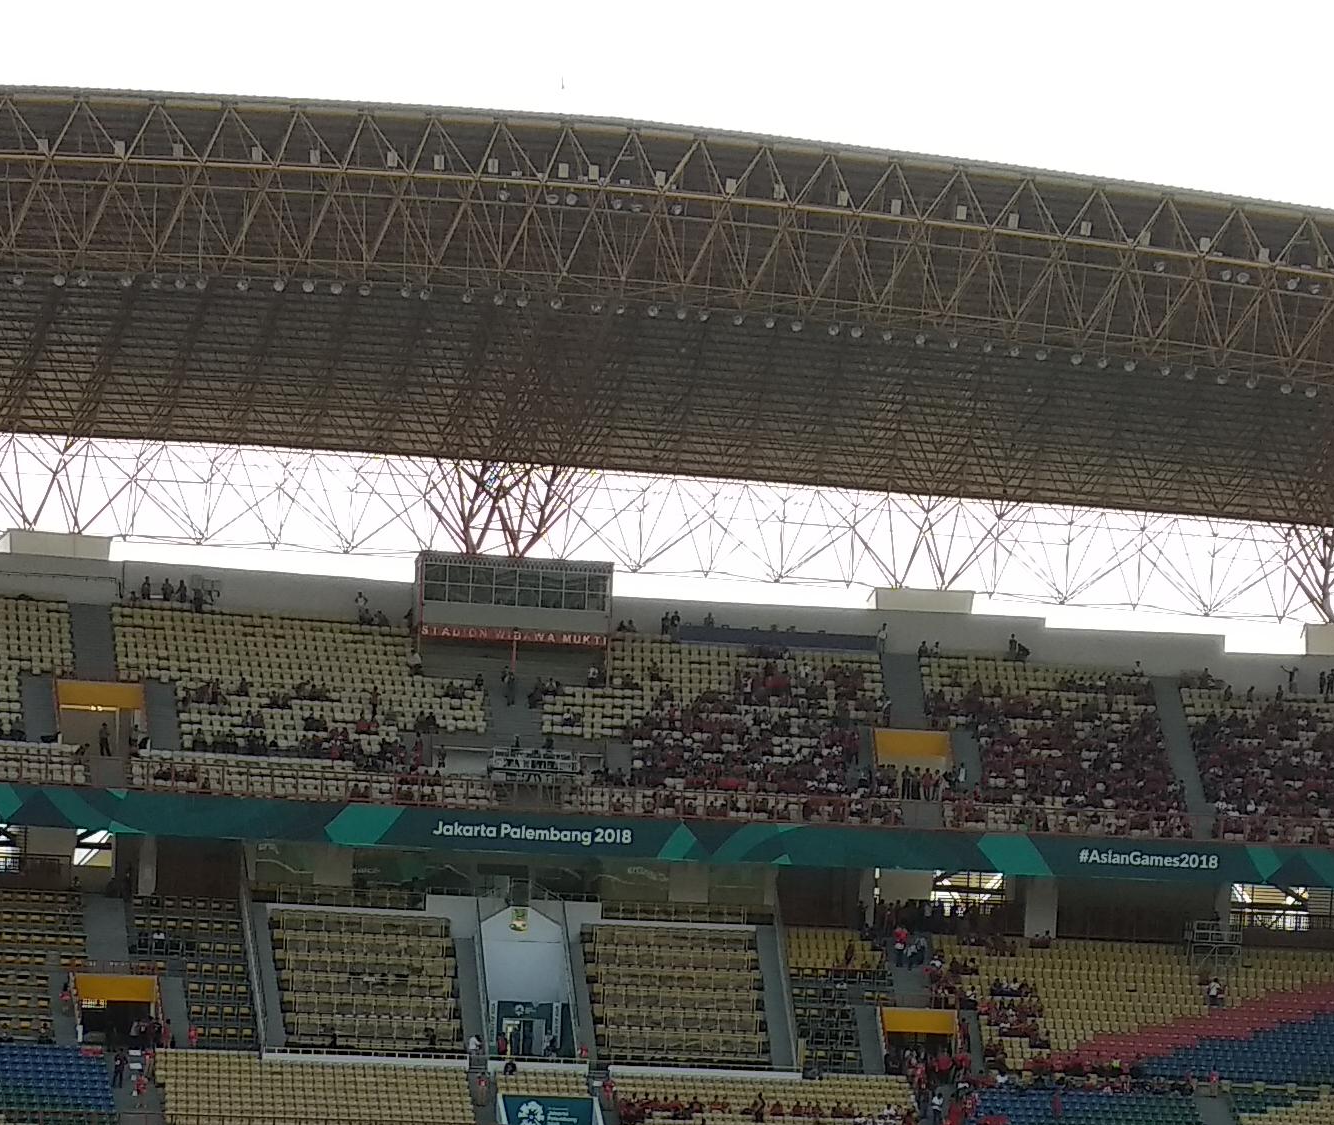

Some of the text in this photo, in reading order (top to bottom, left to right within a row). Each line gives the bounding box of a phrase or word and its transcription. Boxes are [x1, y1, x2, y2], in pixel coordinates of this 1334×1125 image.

[562, 633, 607, 646] MUKTI
[432, 821, 632, 845] Jakarta Palembang 2018
[1078, 847, 1219, 870] #AsianGames2018
